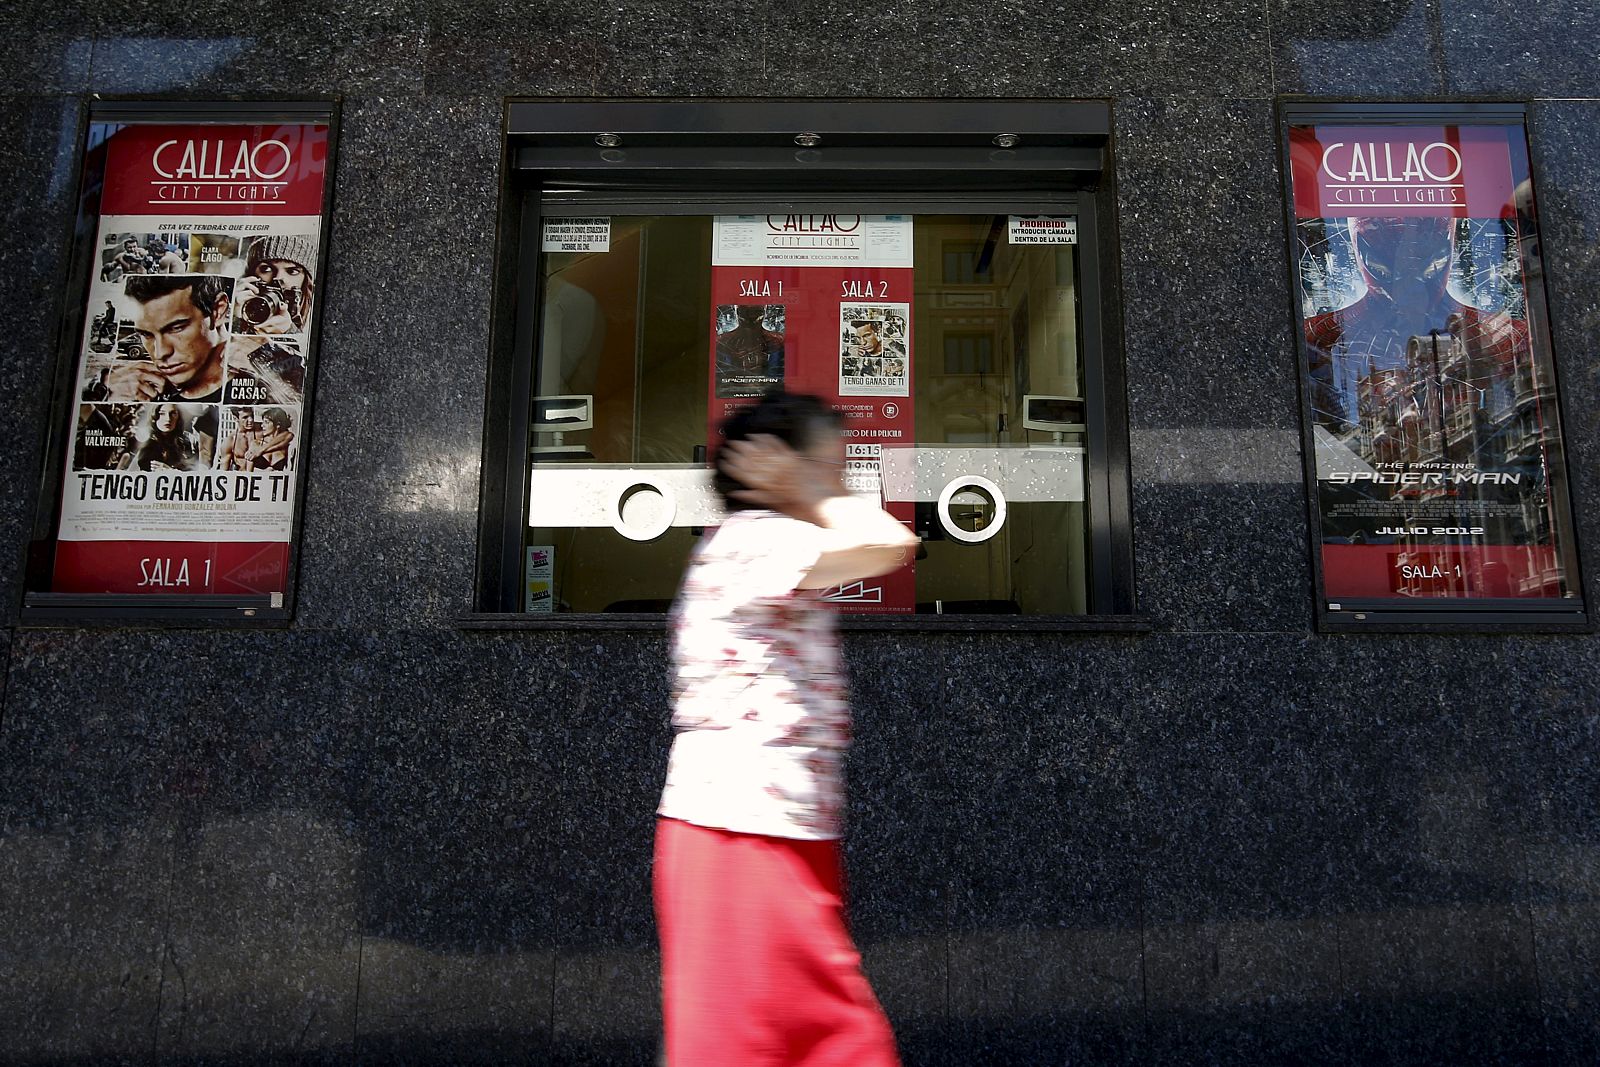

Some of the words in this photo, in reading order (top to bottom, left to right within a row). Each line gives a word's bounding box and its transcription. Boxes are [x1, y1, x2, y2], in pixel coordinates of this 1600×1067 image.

[152, 139, 292, 180] CALLAO
[1322, 142, 1462, 182] CALLAO
[158, 185, 200, 199] CITY
[216, 185, 280, 199] LIGHTS
[1335, 188, 1377, 203] CITY
[1394, 188, 1458, 203] LIGHTS
[766, 214, 860, 232] CALLAO
[1019, 220, 1067, 228] PROHIBIDO
[772, 236, 801, 246] CITY
[812, 237, 855, 246] LIGHTS
[201, 253, 223, 263] LAGO
[739, 280, 771, 297] SALA
[778, 280, 783, 297] 1
[841, 280, 874, 298] SALA
[879, 281, 888, 298] 2
[231, 378, 255, 387] MARIO
[843, 377, 864, 385] TENGO
[865, 377, 887, 386] GANAS
[888, 378, 896, 386] DE
[898, 378, 904, 386] TI
[231, 387, 267, 400] CASAS
[85, 436, 126, 447] VALVERDE
[848, 445, 880, 455] 16:15
[847, 462, 880, 471] 19:00
[1327, 472, 1521, 485] SPIDER-MAN
[78, 473, 148, 501] TENGO
[155, 475, 228, 501] GANAS
[234, 475, 262, 502] DE
[269, 475, 289, 502] TI
[1375, 527, 1428, 535] JULIO
[1432, 527, 1485, 535] 2012
[137, 558, 190, 587] SALA
[204, 559, 211, 587] 1
[1402, 565, 1442, 579] SALA
[1454, 565, 1462, 578] 1
